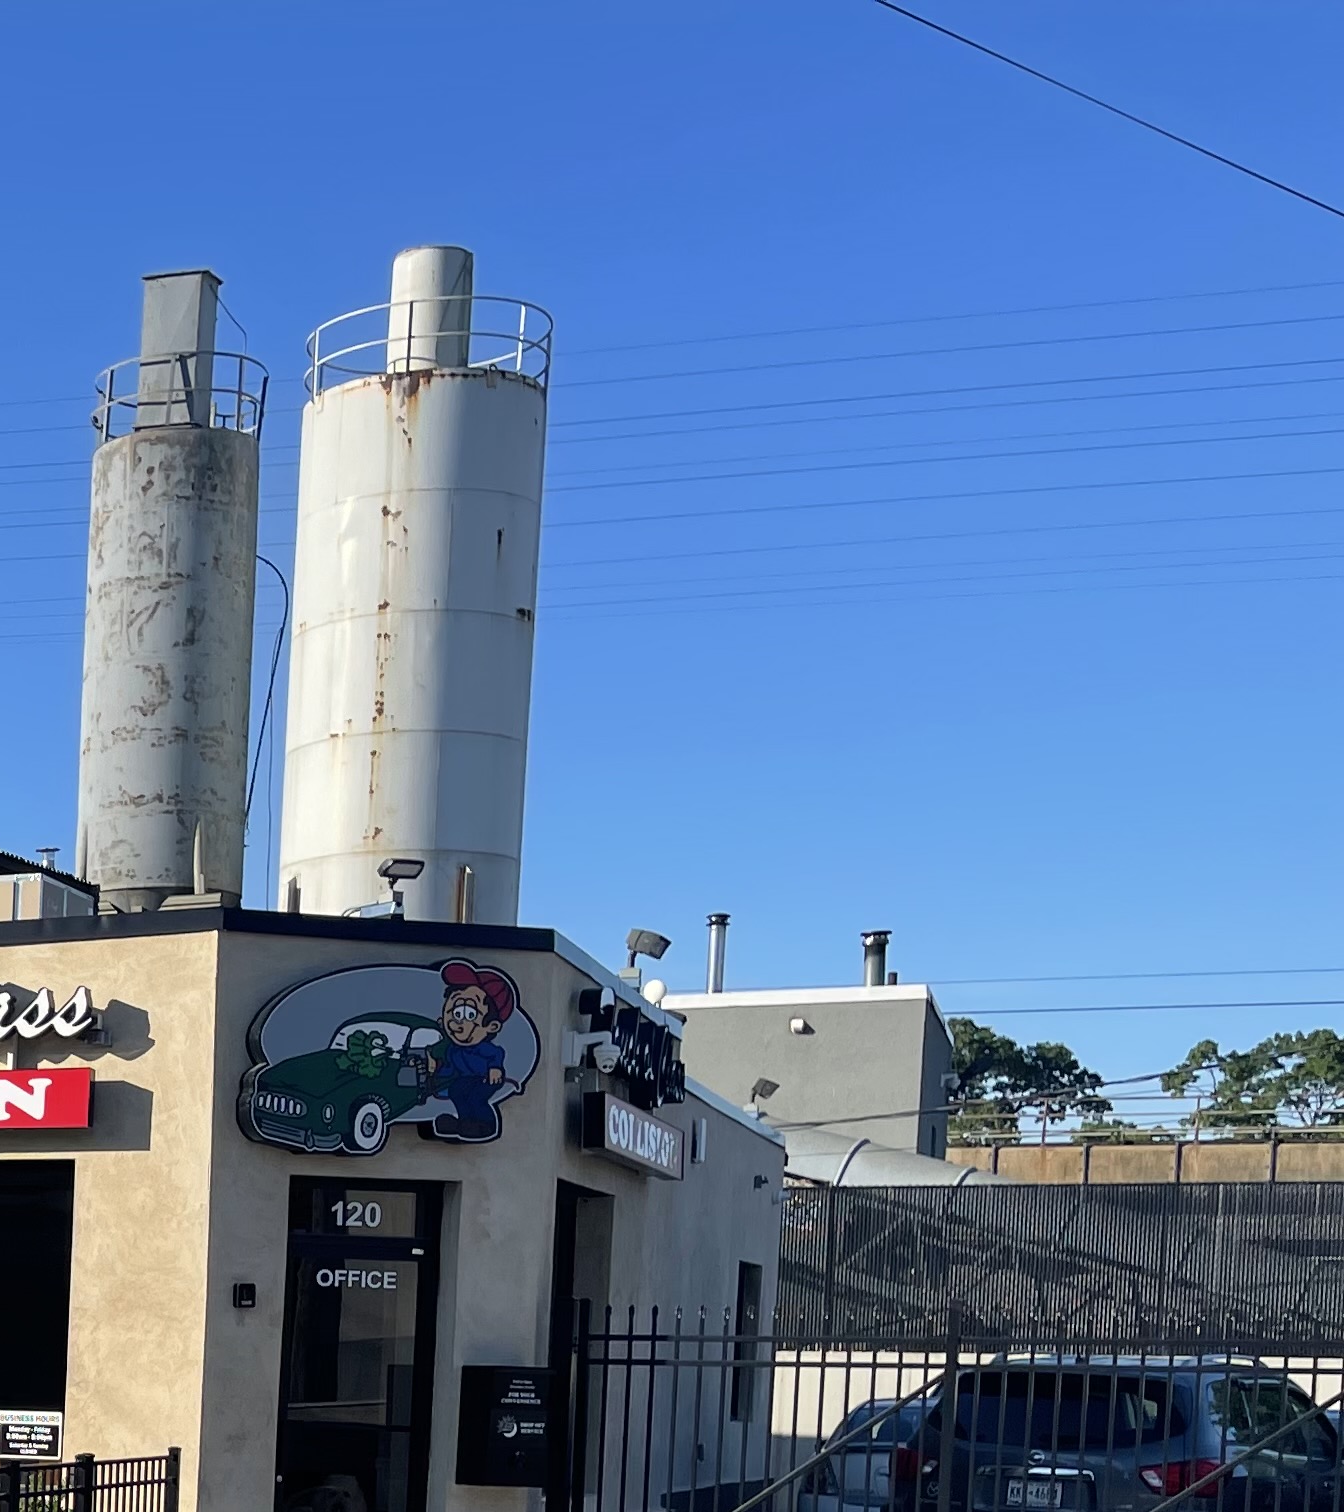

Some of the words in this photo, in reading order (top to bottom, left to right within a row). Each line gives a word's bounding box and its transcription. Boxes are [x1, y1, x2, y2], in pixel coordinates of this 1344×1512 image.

[331, 1200, 382, 1228] 120
[316, 1268, 397, 1289] OFFICE
[0, 1414, 34, 1422] BUSINESS
[36, 1415, 60, 1423] HOURS
